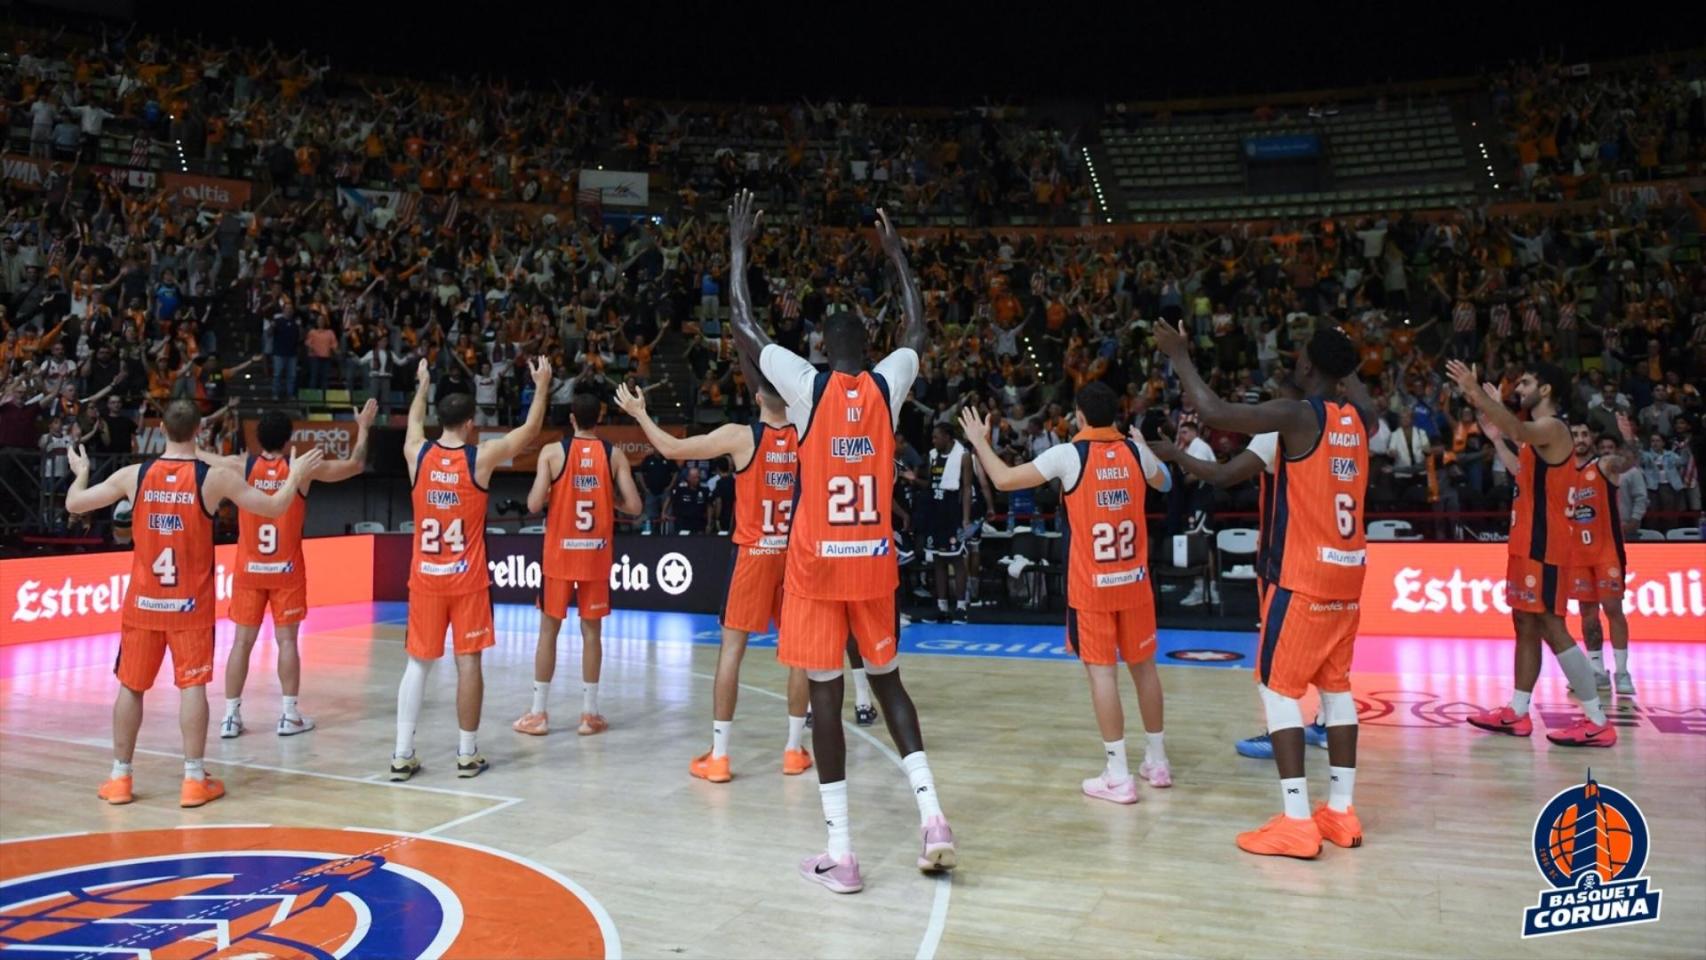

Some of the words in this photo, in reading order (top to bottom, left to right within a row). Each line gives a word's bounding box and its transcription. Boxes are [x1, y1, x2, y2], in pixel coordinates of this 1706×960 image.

[847, 408, 861, 422] ILY
[831, 437, 876, 458] LEYMA
[430, 471, 459, 484] CREMO
[1096, 467, 1130, 480] VARELA
[143, 490, 195, 504] JORGENSEN
[427, 490, 460, 505] LEYMA
[827, 475, 880, 525] 21
[1096, 489, 1131, 507] LEYMA
[148, 514, 184, 530] LEYMA
[575, 500, 594, 531] 5
[762, 499, 792, 534] 13
[1335, 493, 1356, 539] 6
[257, 523, 278, 554] 9
[421, 518, 466, 554] 24
[1092, 520, 1135, 563] 22
[1581, 529, 1592, 545] 0
[826, 543, 868, 556] Aluman
[152, 547, 177, 587] 4
[1100, 573, 1133, 586] Aluman
[140, 599, 176, 610] Aluman
